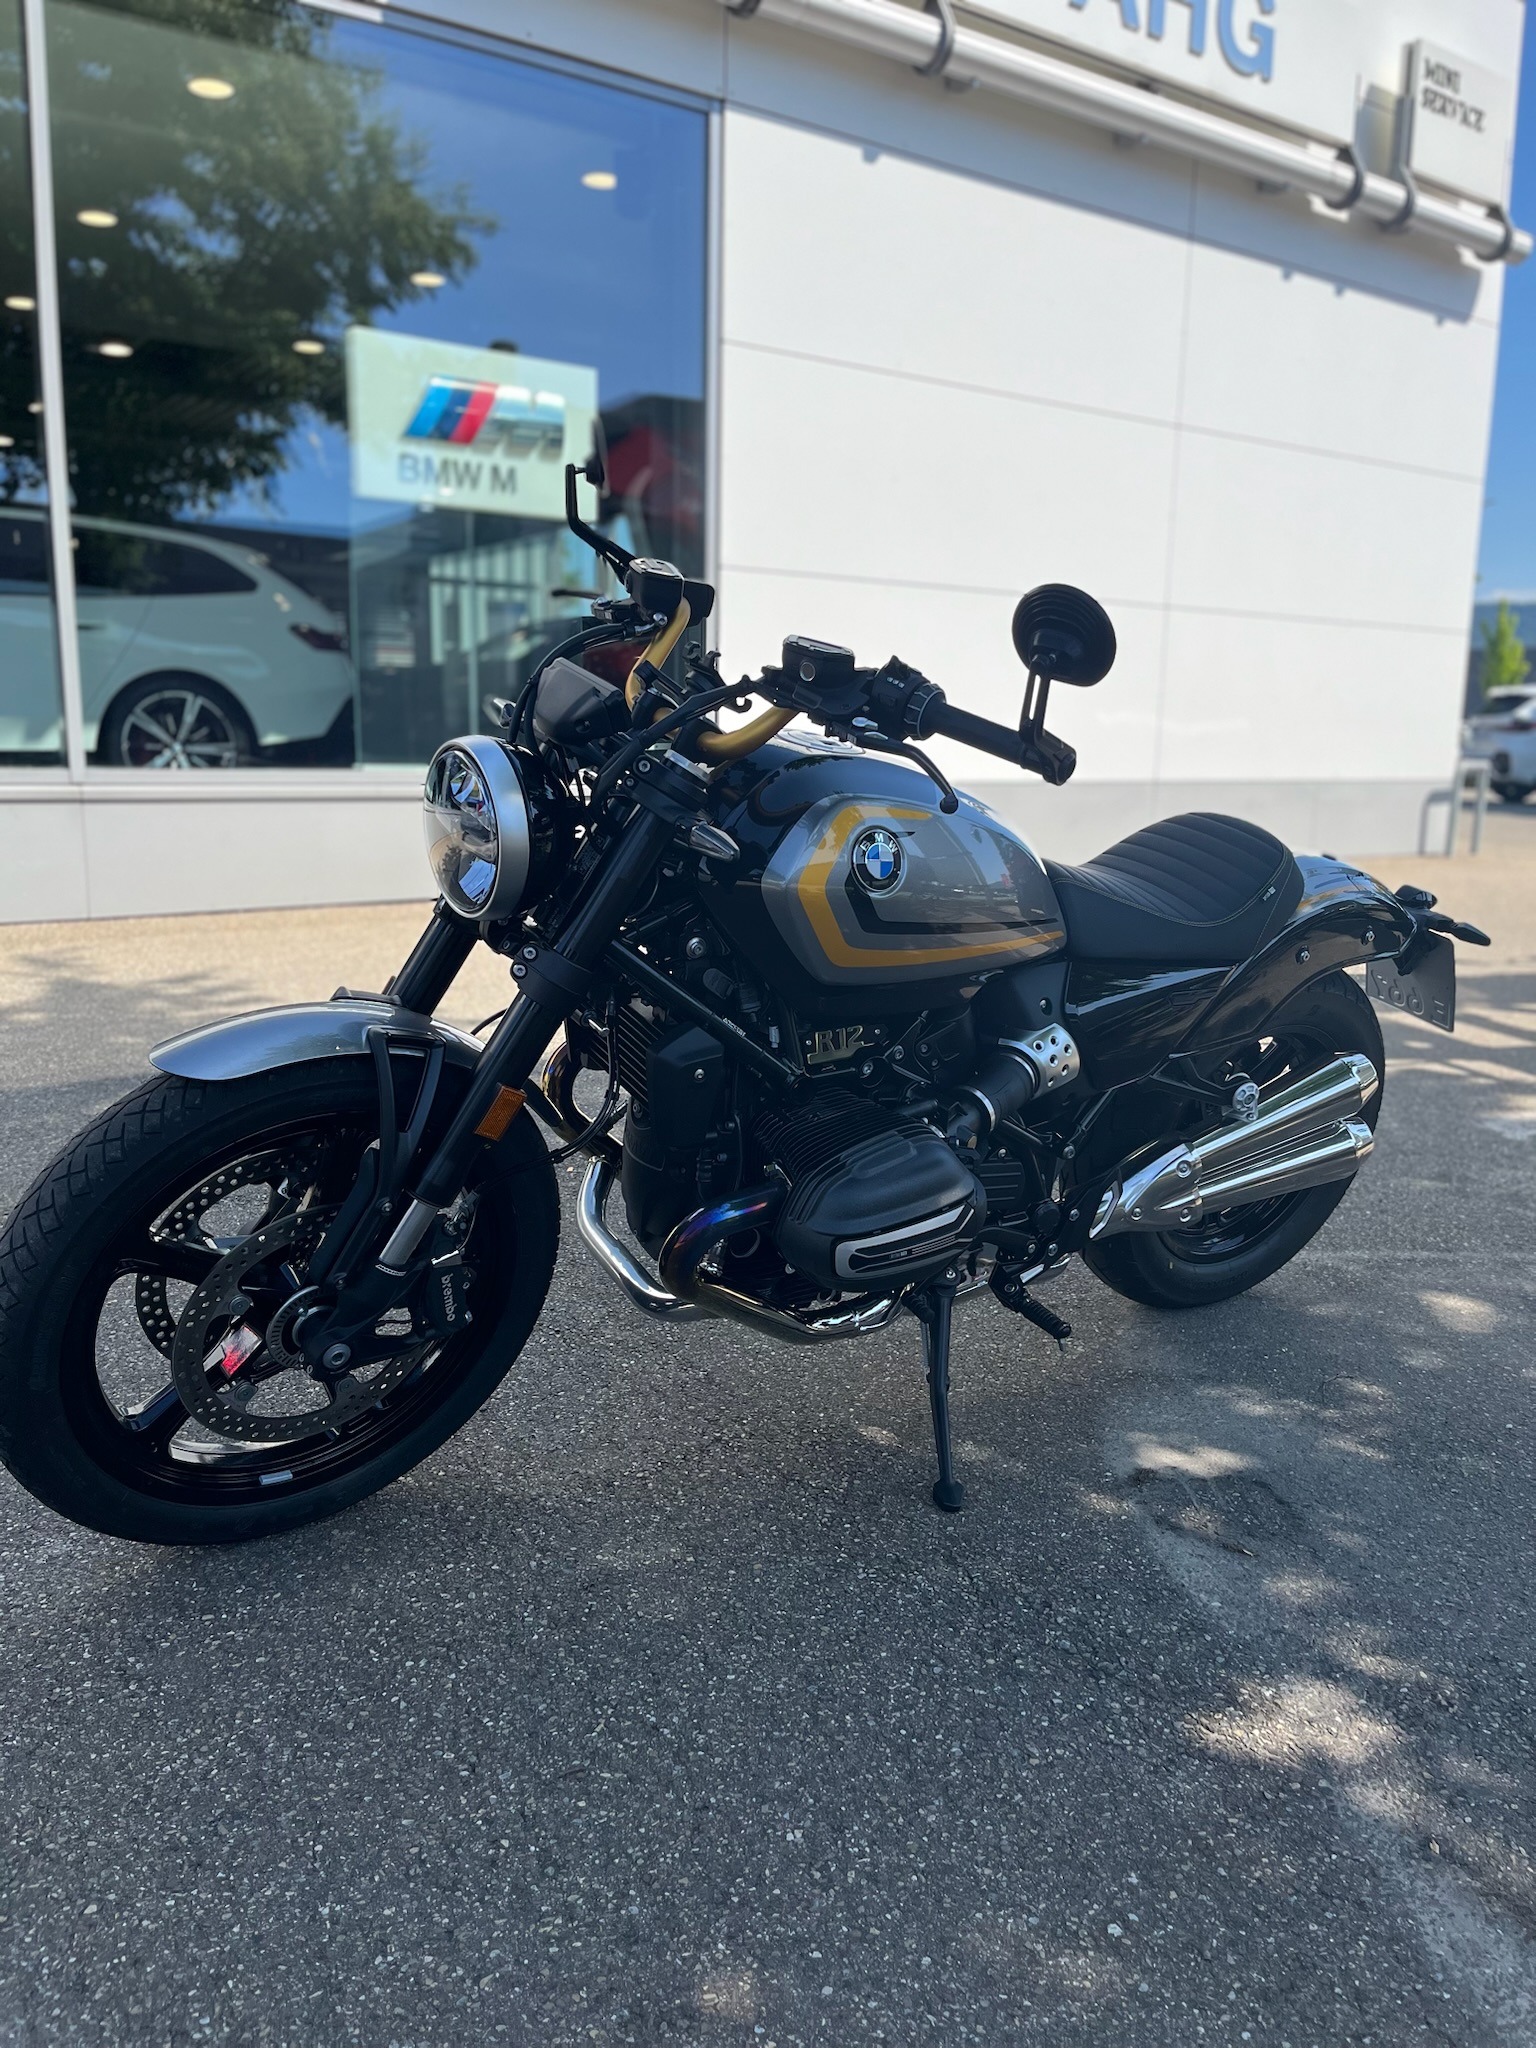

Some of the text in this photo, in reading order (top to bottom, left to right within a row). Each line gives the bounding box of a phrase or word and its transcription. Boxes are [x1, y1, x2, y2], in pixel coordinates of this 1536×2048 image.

[397, 453, 517, 494] BMW M
[860, 833, 898, 853] BMW
[440, 1273, 458, 1322] brembo
